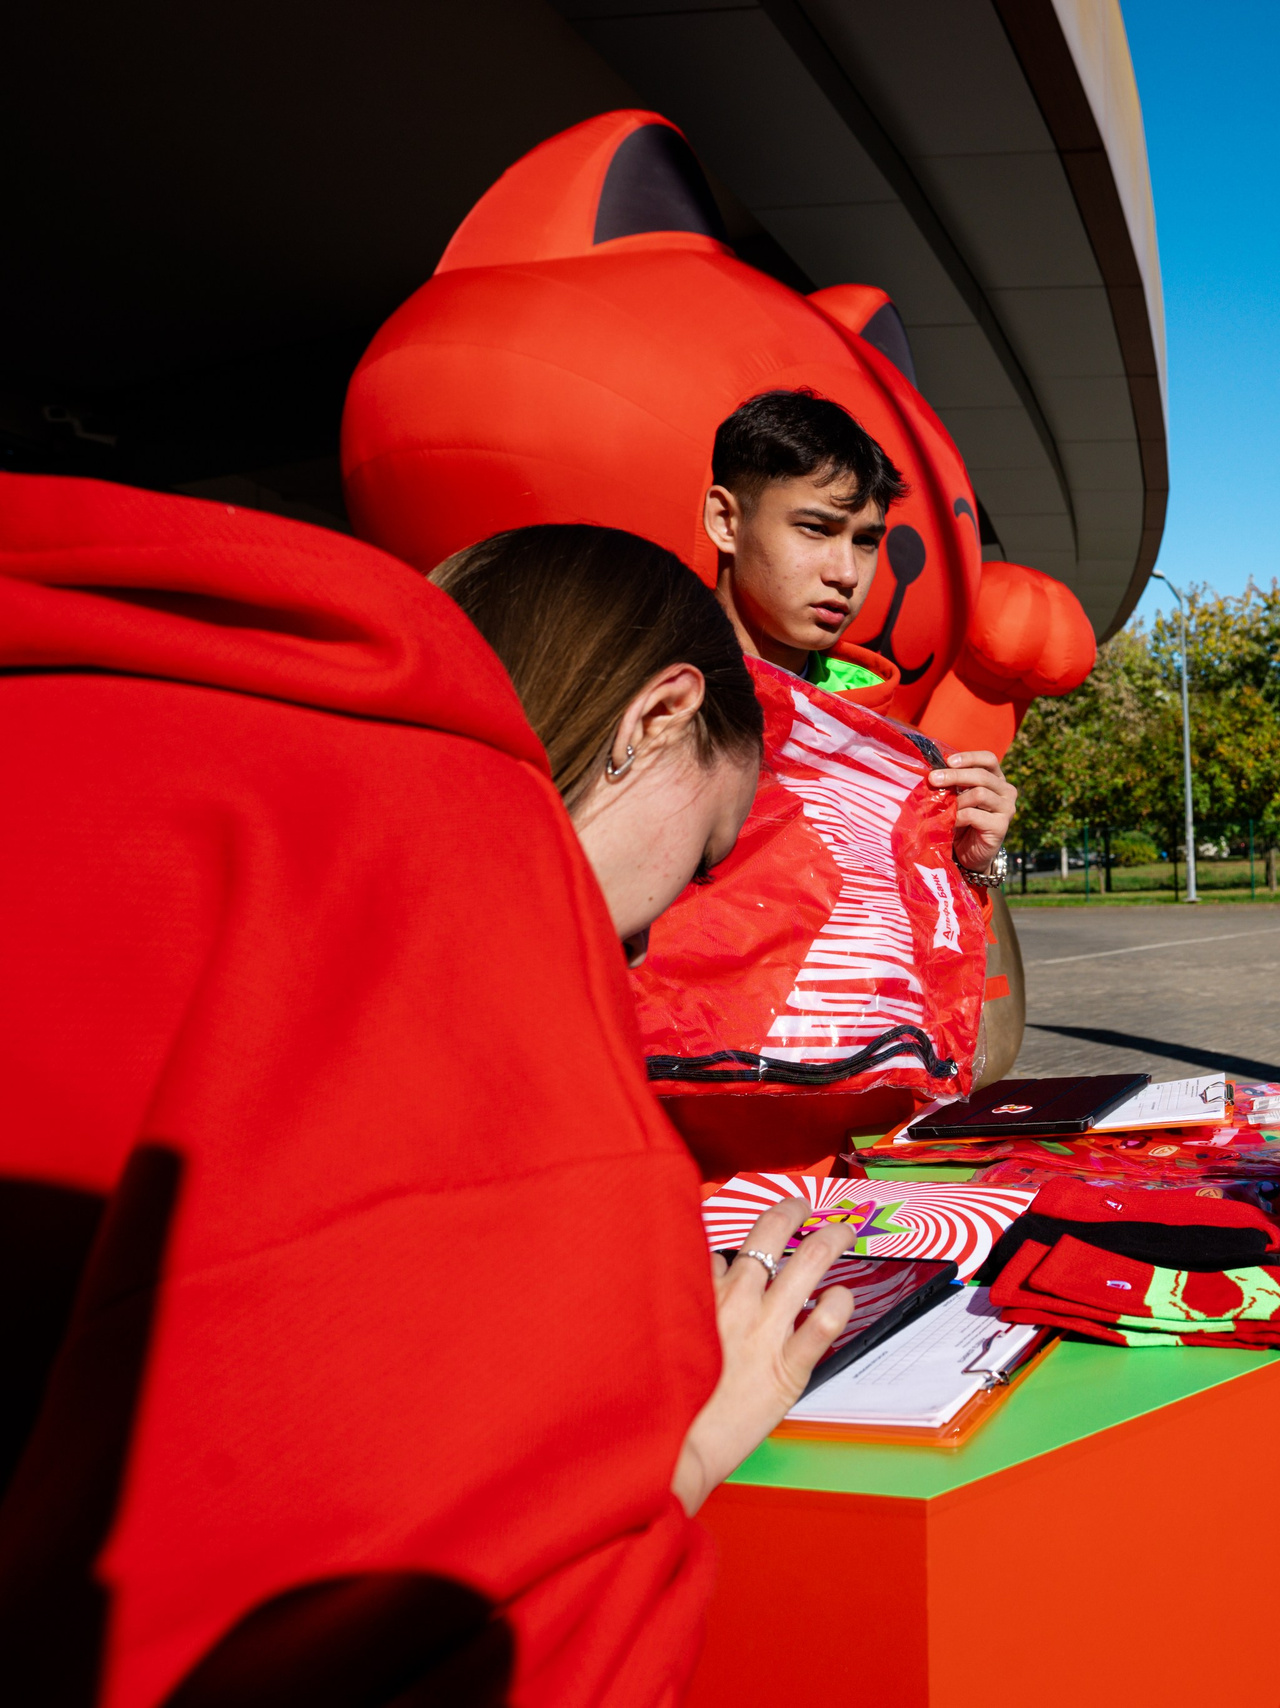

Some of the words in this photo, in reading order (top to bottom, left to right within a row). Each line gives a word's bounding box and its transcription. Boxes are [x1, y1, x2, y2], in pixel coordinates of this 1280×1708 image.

[776, 686, 925, 880] СВОБОДНЫХ
[930, 873, 949, 899] Банк
[942, 900, 955, 941] Альфа
[794, 886, 924, 994] УМНЫХ
